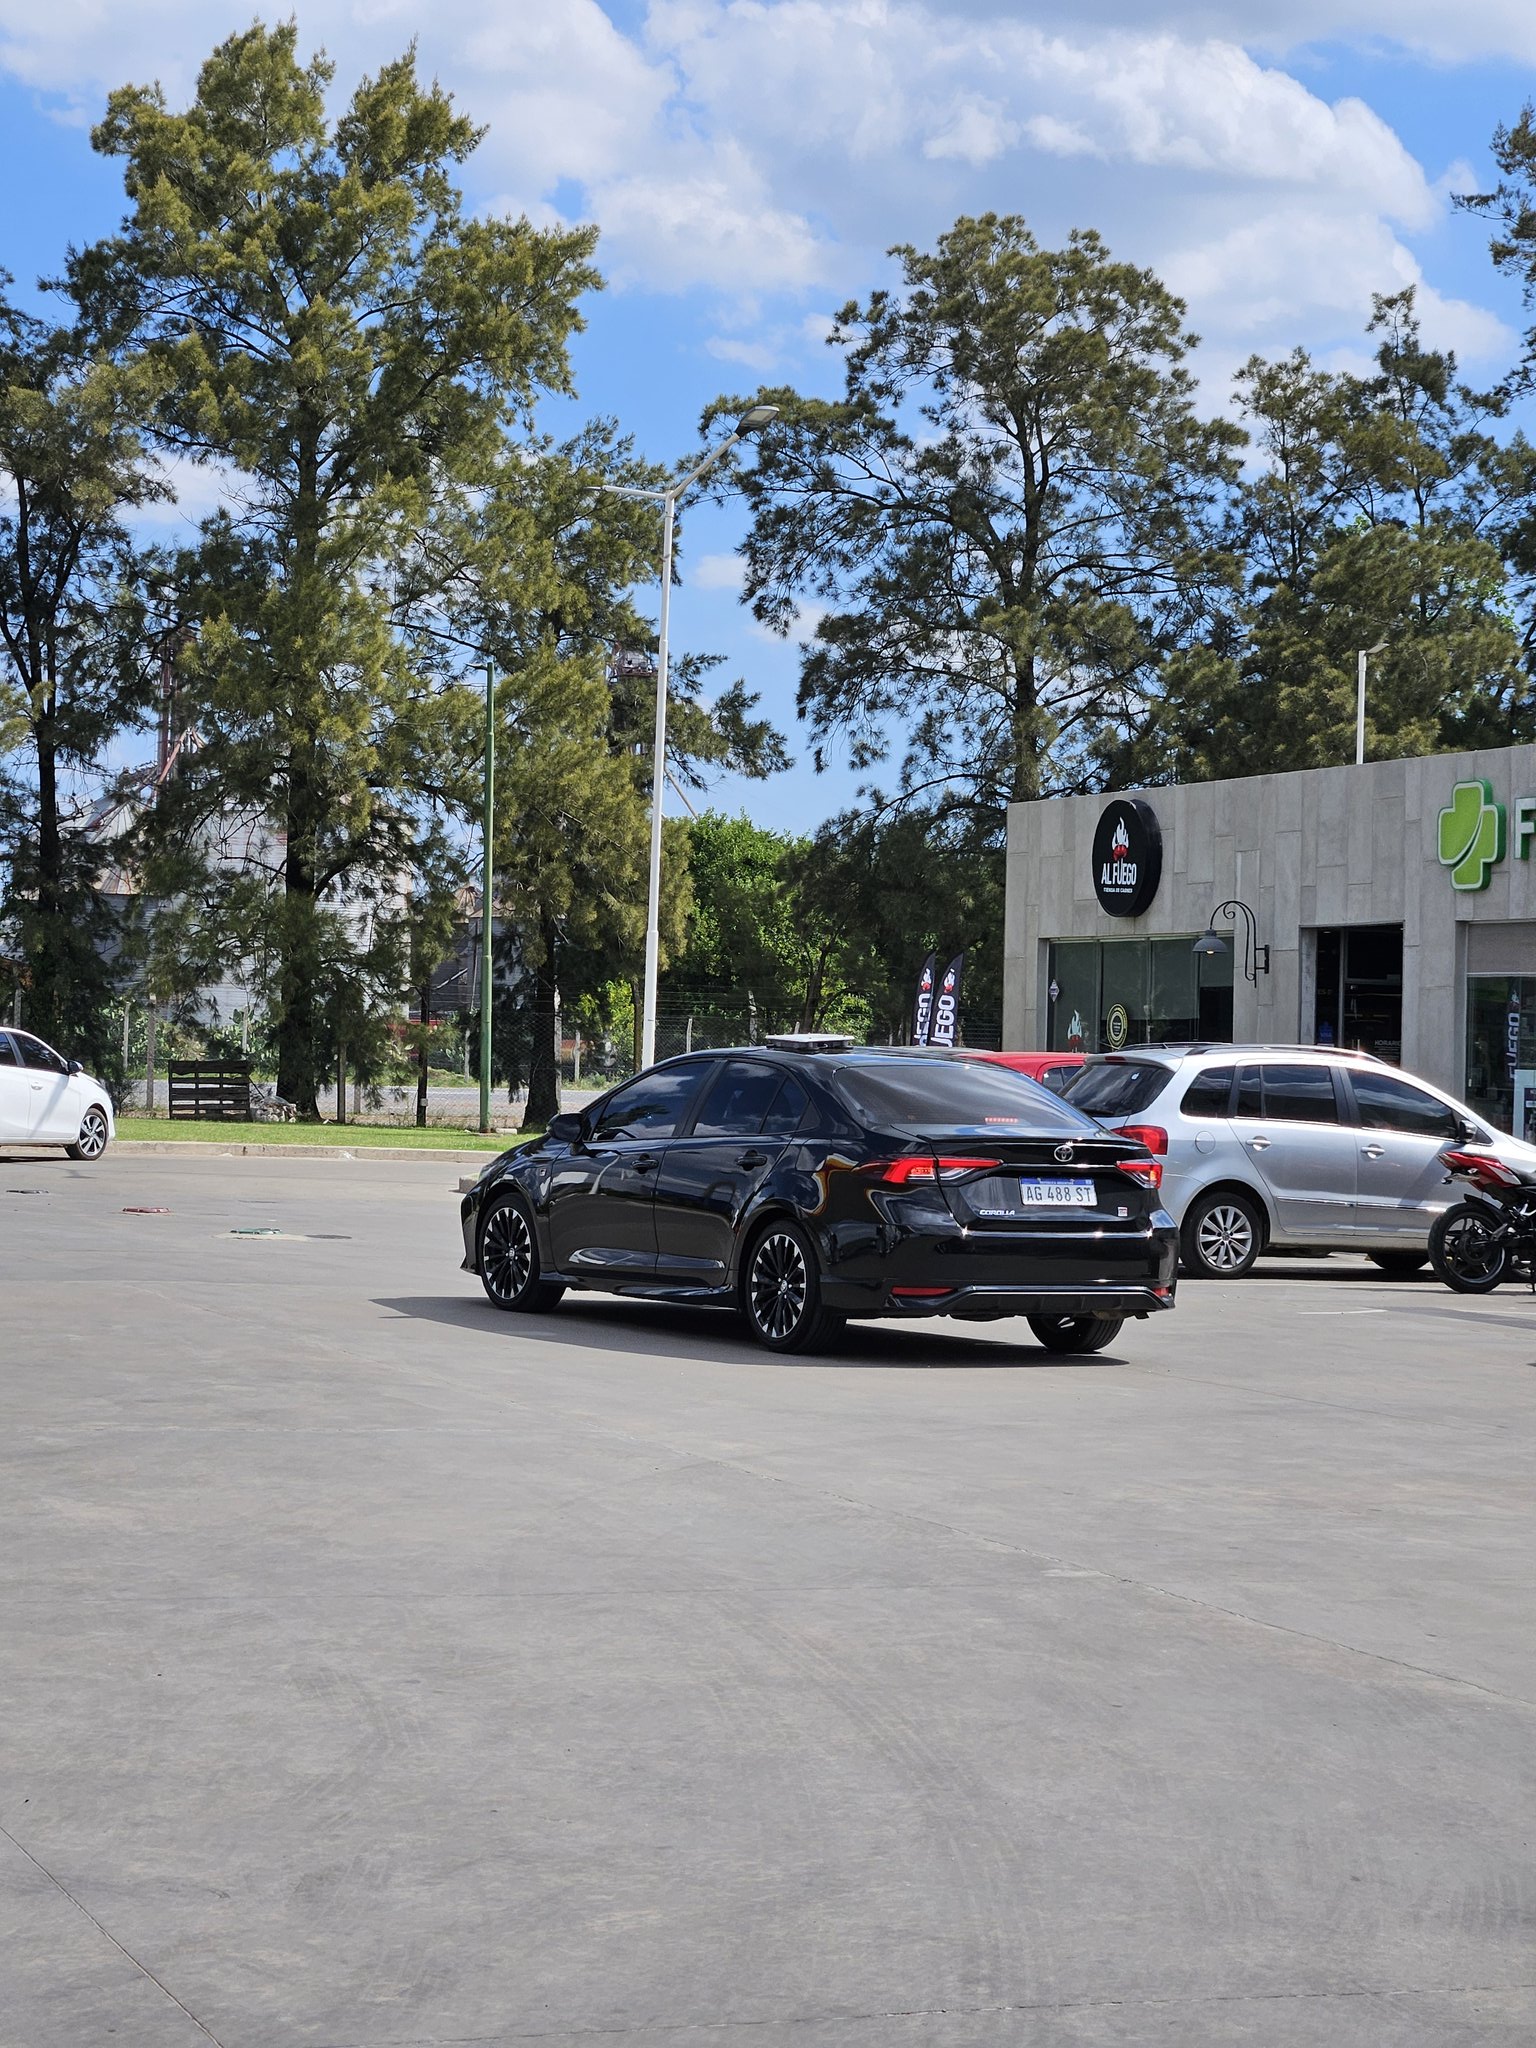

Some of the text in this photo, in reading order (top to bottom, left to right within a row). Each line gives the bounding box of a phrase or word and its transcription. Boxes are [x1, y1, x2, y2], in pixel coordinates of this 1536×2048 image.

[1101, 858, 1137, 886] AL FUEGO
[1026, 1186, 1091, 1202] AG 488 ST
